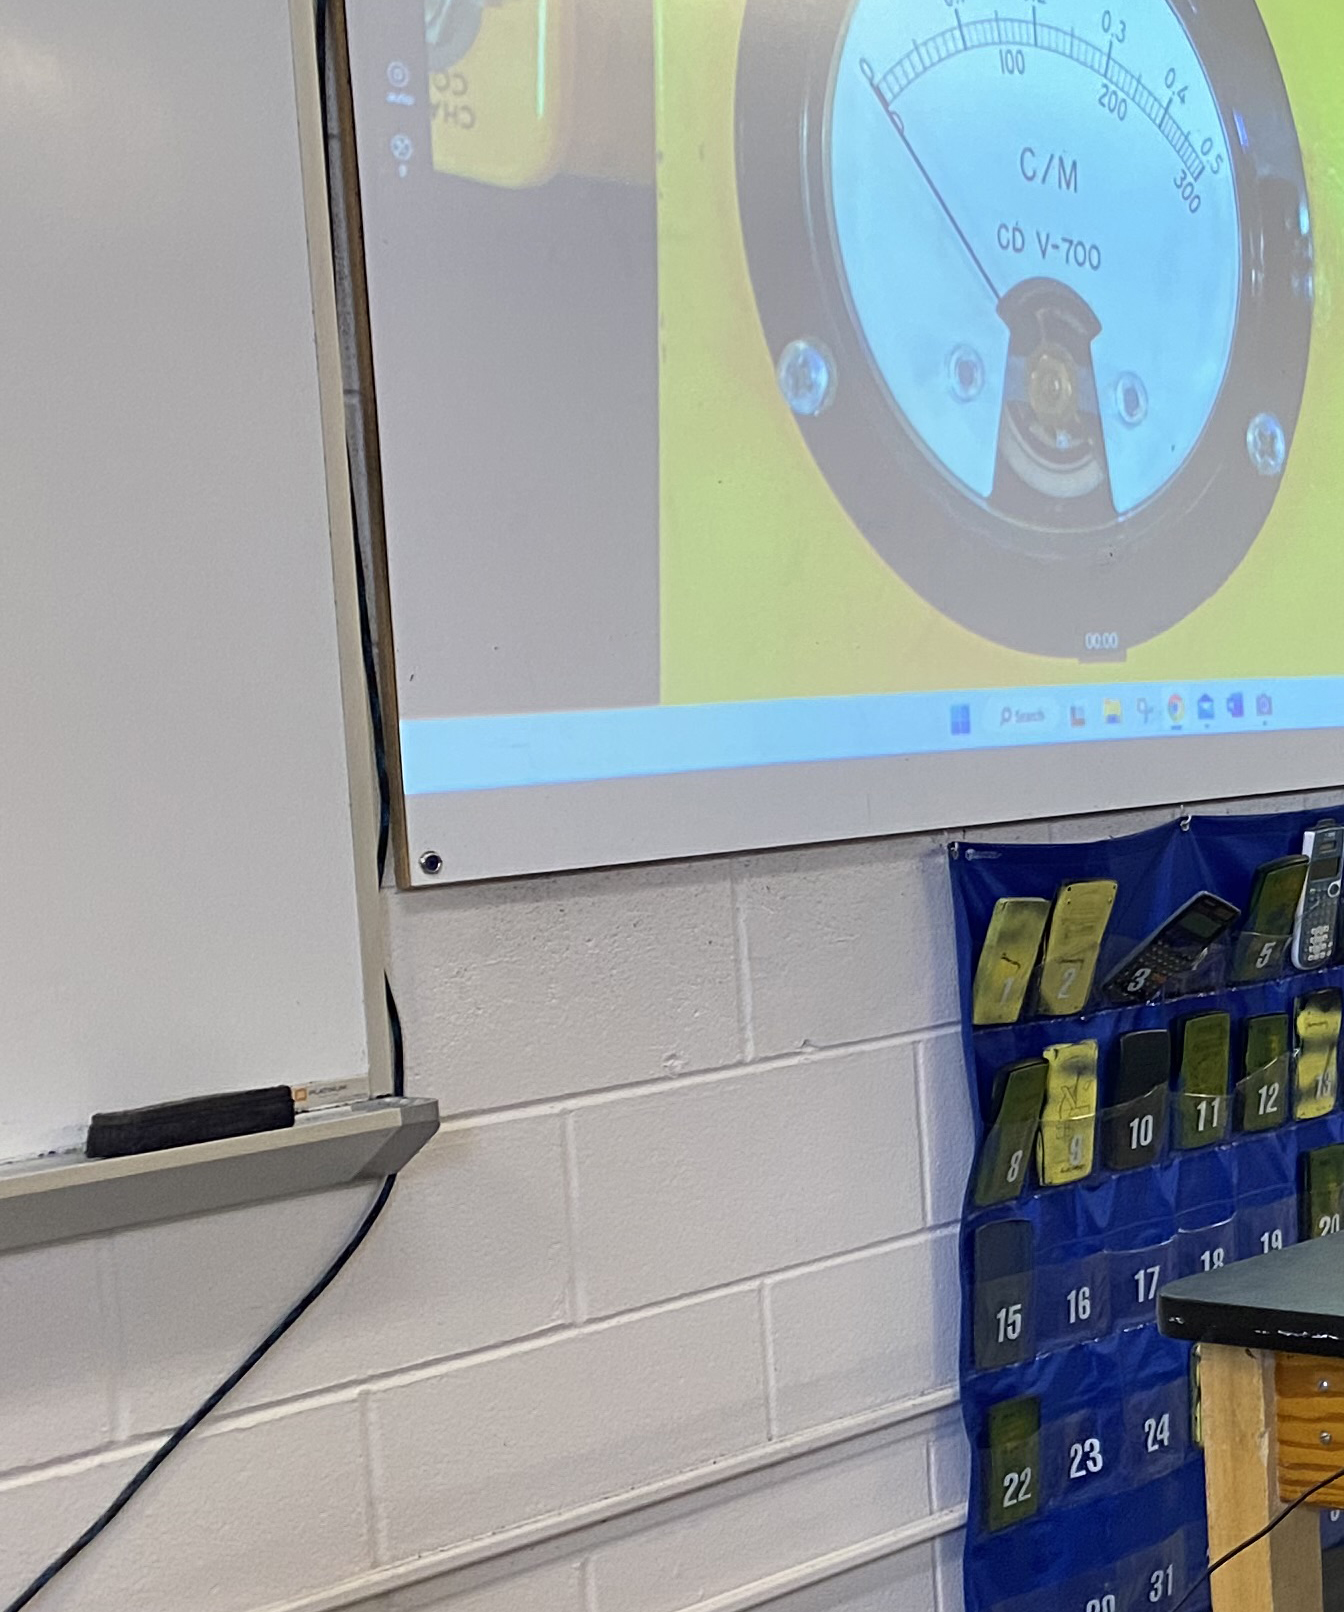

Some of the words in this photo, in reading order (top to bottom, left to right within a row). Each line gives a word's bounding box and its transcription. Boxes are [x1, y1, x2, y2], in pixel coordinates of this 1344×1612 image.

[1102, 10, 1127, 43] 0.3
[1000, 49, 1025, 75] 100
[1098, 83, 1128, 121] 200
[1164, 68, 1190, 104] 0.4
[1020, 147, 1078, 193] C/M
[1201, 137, 1224, 175] 0.5
[1173, 169, 1201, 214] 300
[997, 222, 1025, 253] CD
[1036, 230, 1101, 271] V-700
[1058, 969, 1076, 999] 2
[1127, 967, 1150, 992] 3
[1256, 942, 1276, 969] 5
[1006, 1150, 1023, 1182] 8
[1070, 1134, 1083, 1165] 9
[1129, 1115, 1154, 1150] 10
[1196, 1096, 1220, 1132] 11
[1258, 1083, 1280, 1116] 12
[1316, 1072, 1332, 1101] 13
[996, 1304, 1022, 1342] 15
[1067, 1286, 1091, 1323] 16
[1134, 1265, 1160, 1302] 17
[1003, 1468, 1032, 1508] 22
[1070, 1438, 1103, 1479] 23
[1144, 1413, 1170, 1454] 24
[1150, 1564, 1173, 1603] 31
